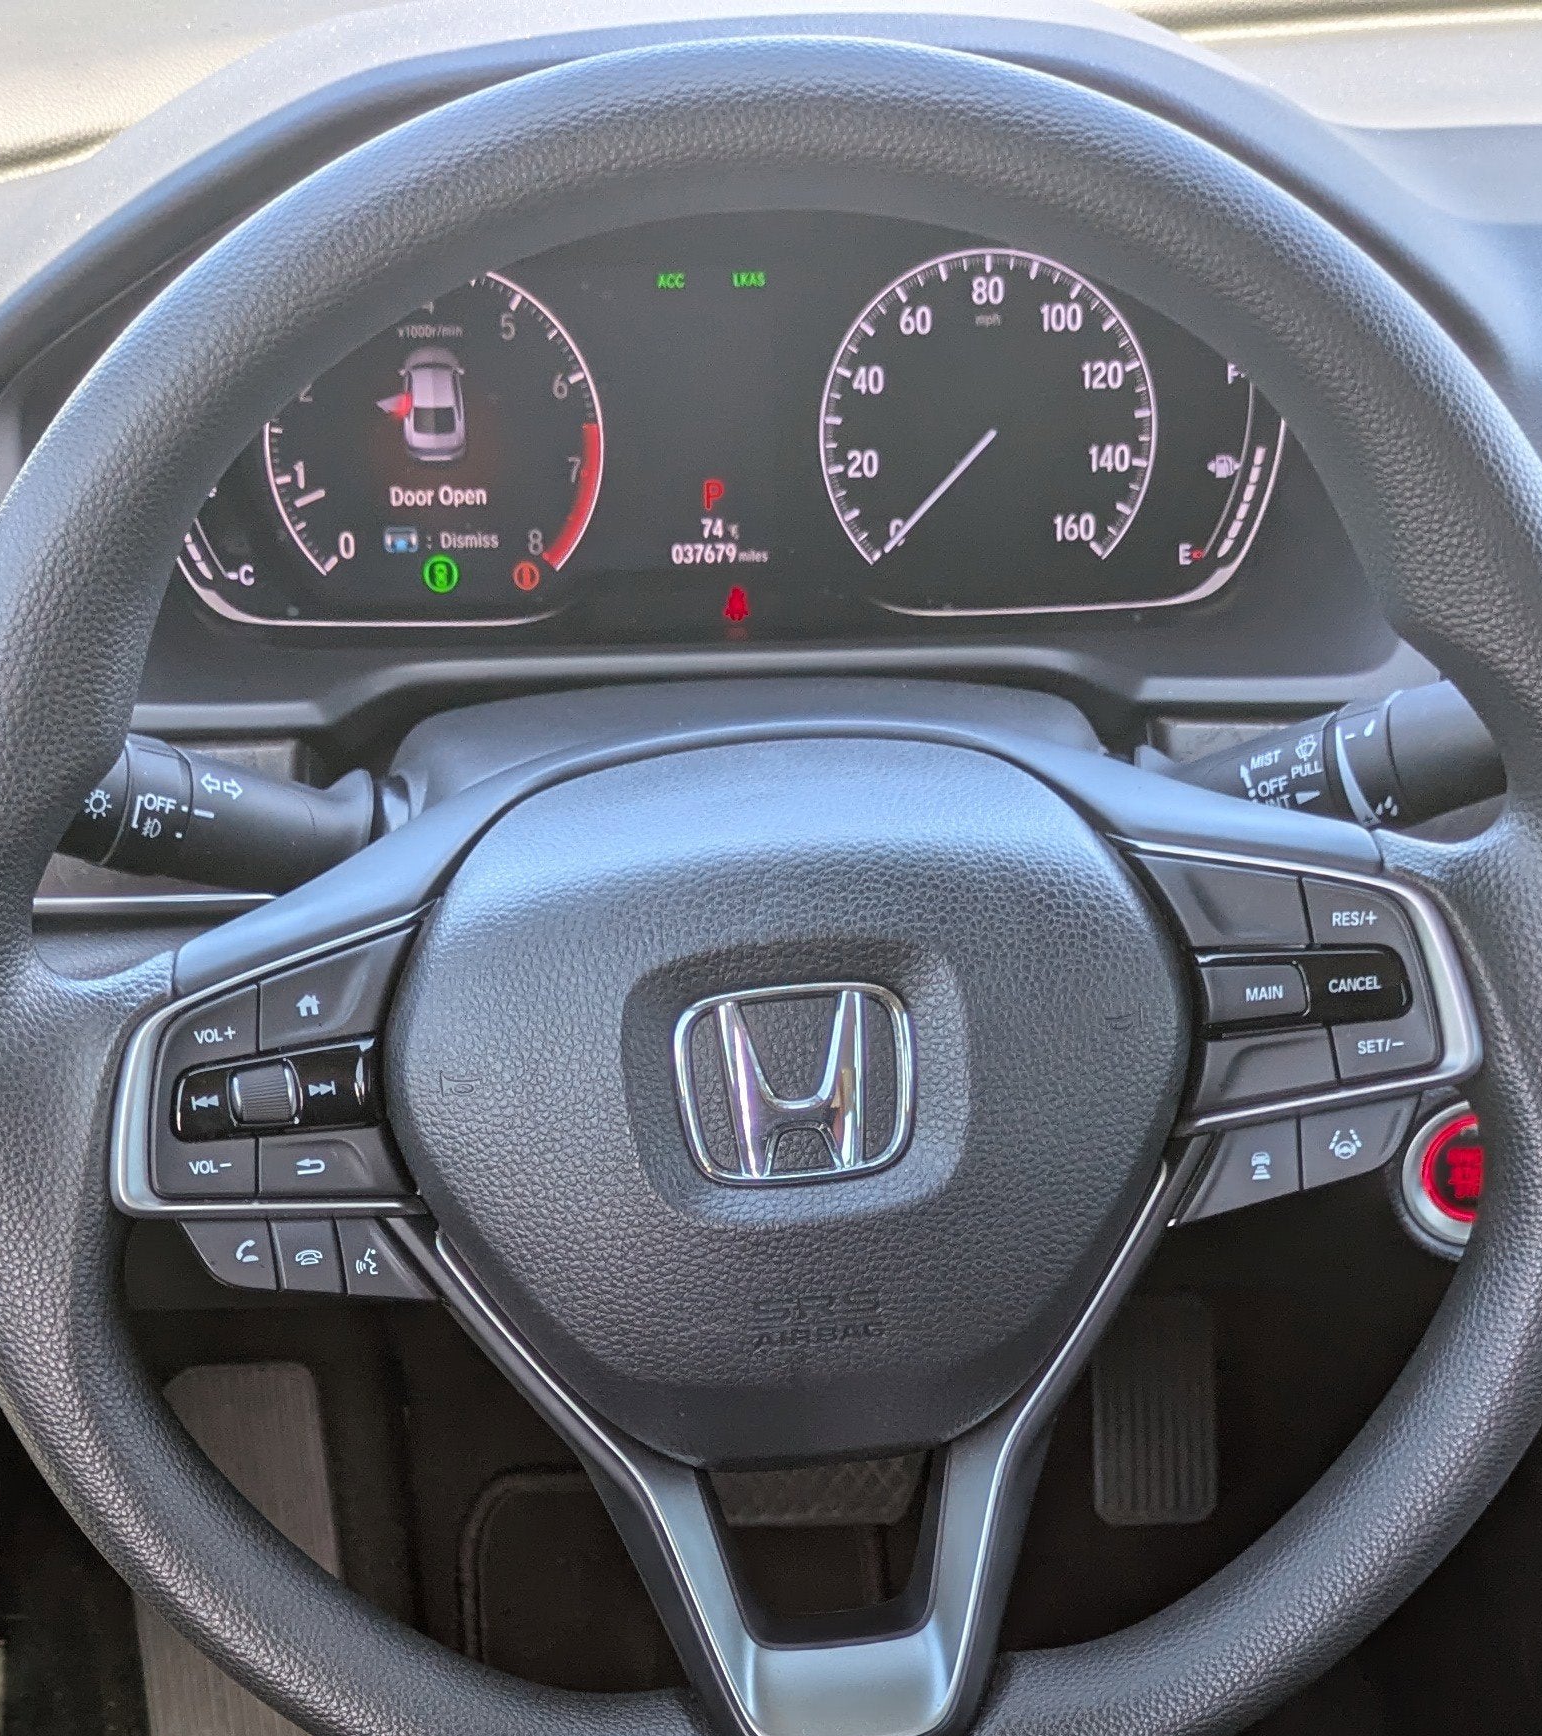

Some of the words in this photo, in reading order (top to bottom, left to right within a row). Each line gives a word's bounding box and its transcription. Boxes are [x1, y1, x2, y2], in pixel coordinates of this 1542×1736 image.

[658, 273, 684, 287] ACC
[971, 276, 1003, 303] 80
[500, 313, 514, 338] 5
[899, 305, 931, 333] 60
[1040, 302, 1081, 331] 100
[552, 374, 567, 398] 6
[852, 365, 883, 393] 40
[1081, 361, 1122, 388] 120
[567, 456, 579, 481] 7
[846, 449, 877, 477] 20
[1088, 444, 1130, 472] 140
[293, 461, 303, 487] 1
[389, 485, 432, 505] Door
[438, 484, 485, 505] Open
[702, 478, 723, 509] P
[700, 517, 722, 537] 74
[1053, 512, 1095, 540] 160
[338, 531, 354, 558] 0
[440, 532, 497, 548] Dismiss
[527, 528, 542, 554] 8
[671, 542, 735, 563] 037679
[1178, 543, 1190, 564] E
[238, 565, 253, 584] C
[1250, 750, 1280, 768] MIST
[1291, 761, 1322, 778] PULL
[1258, 774, 1285, 796] OFF
[144, 793, 175, 812] OFF
[1332, 910, 1376, 926] RES/+
[1245, 984, 1282, 1001] MAIN
[1328, 975, 1380, 992] CANCEL
